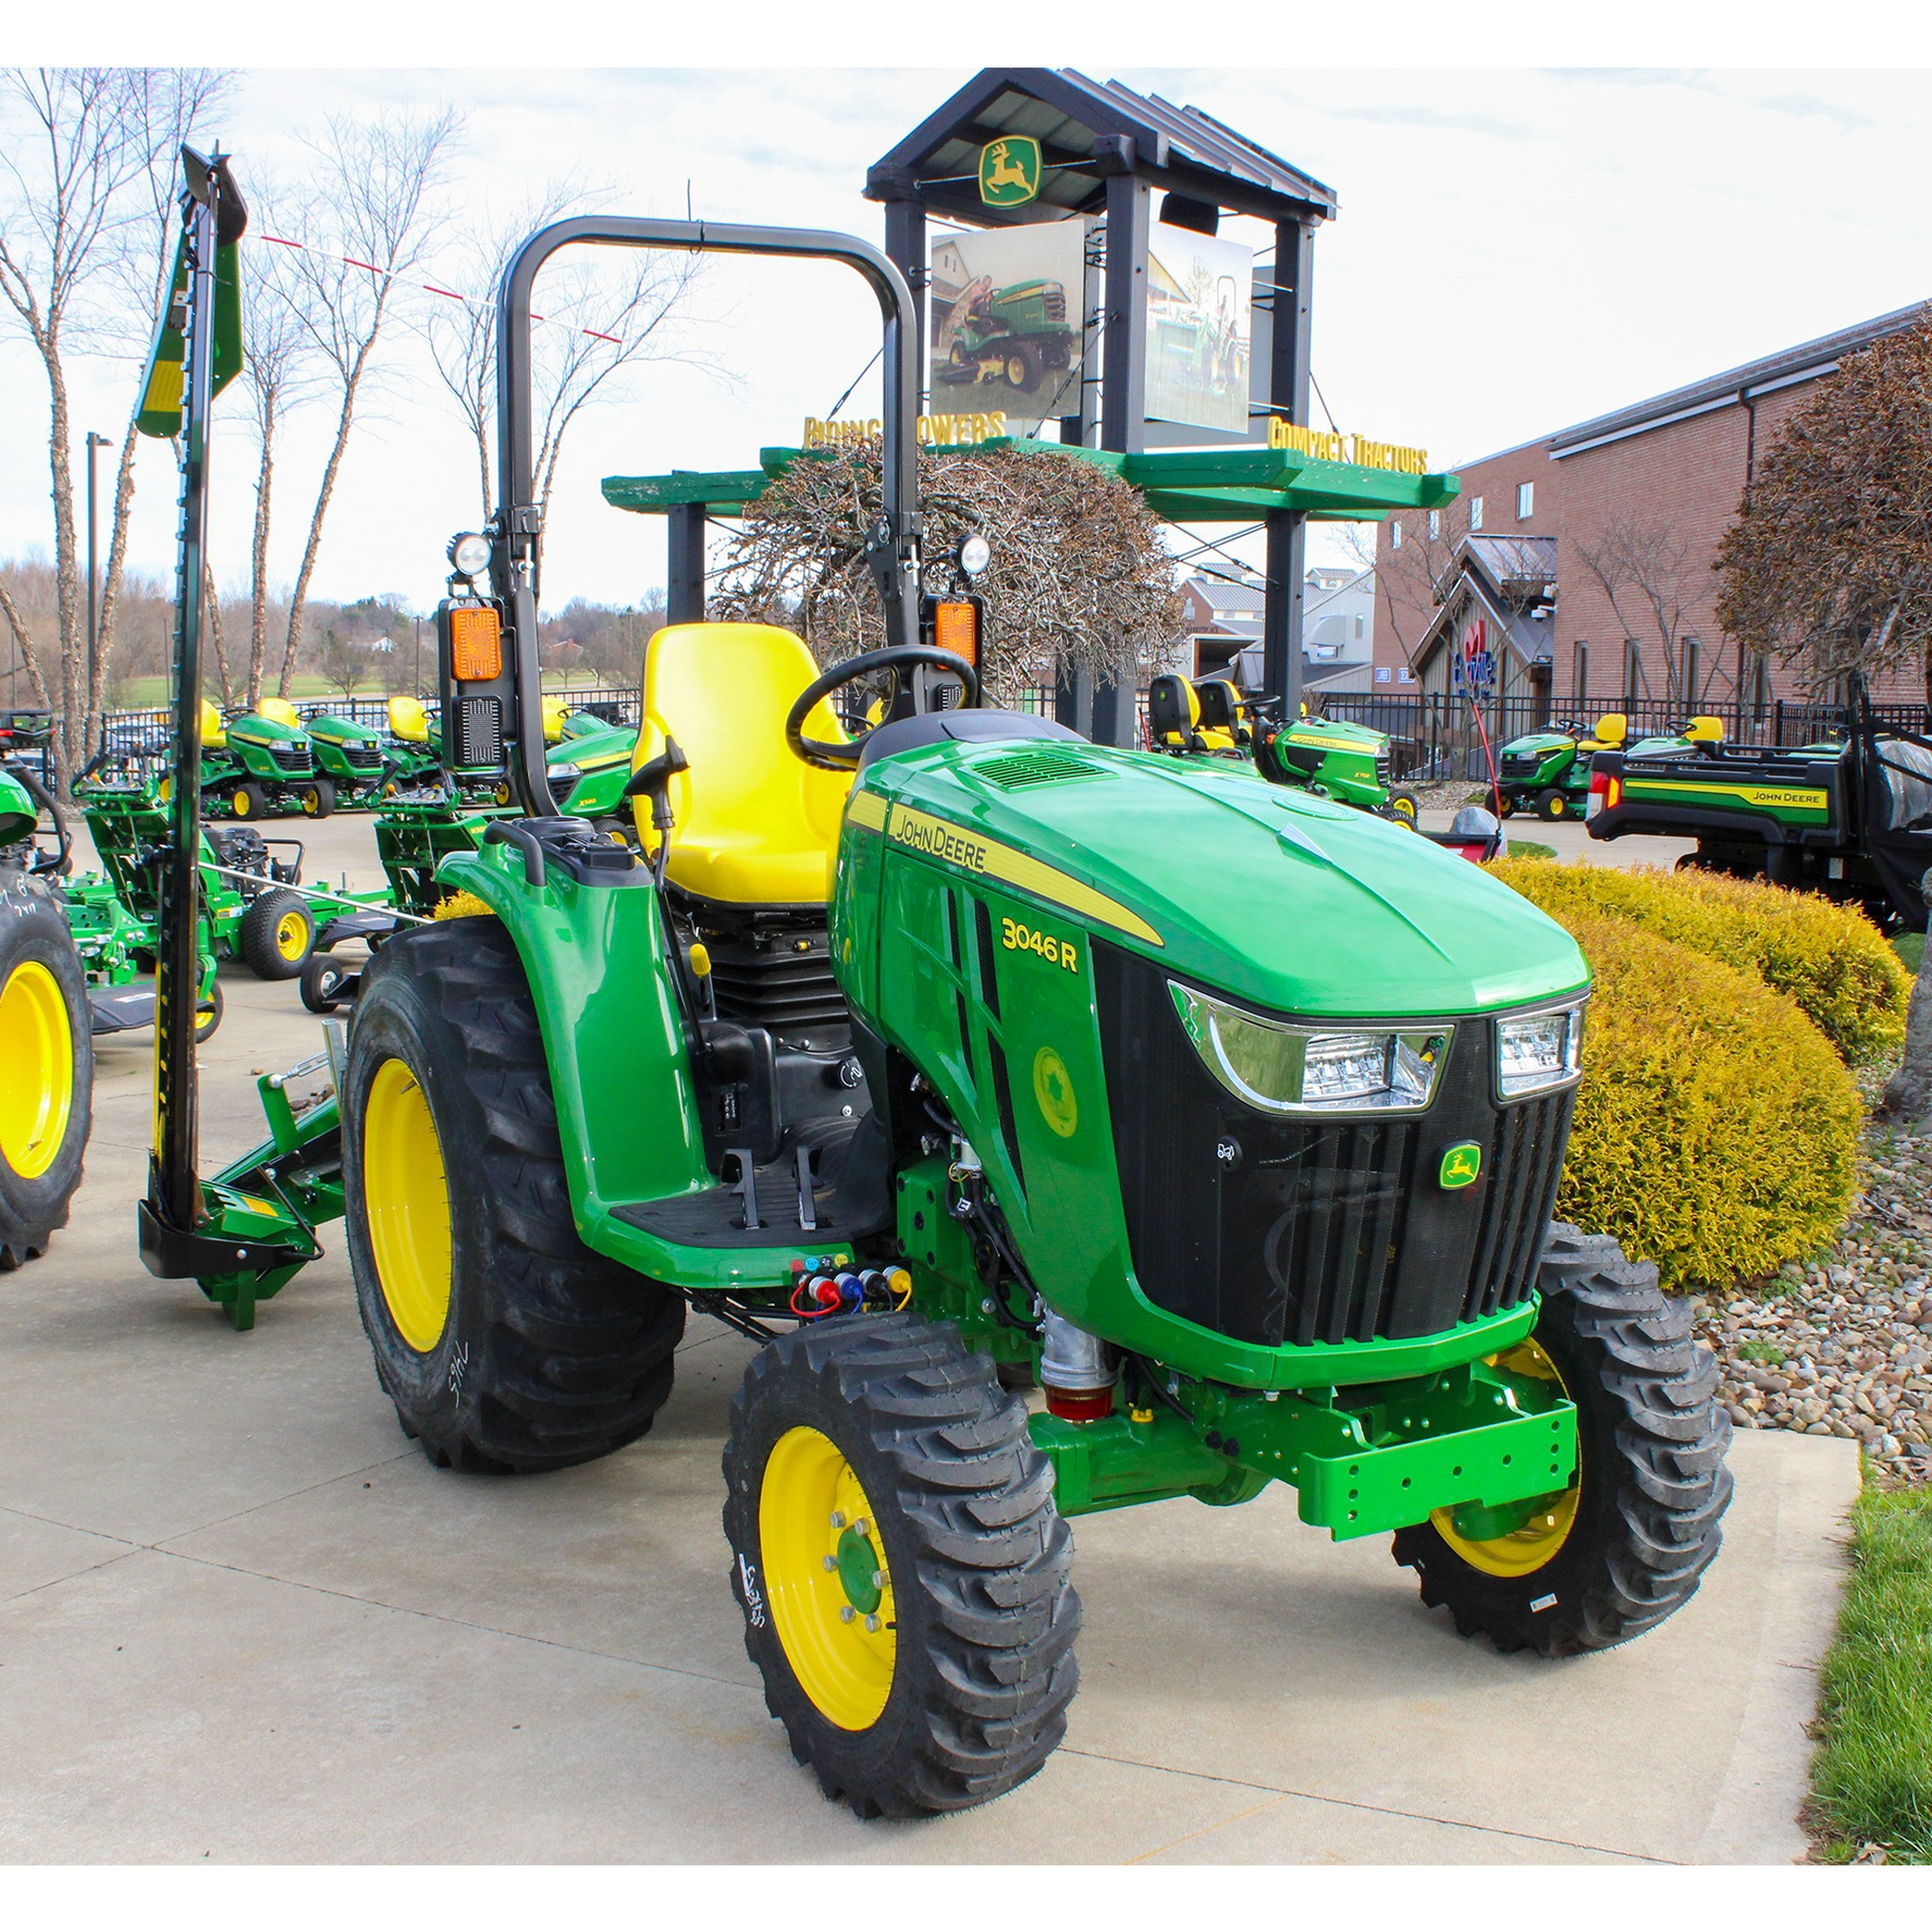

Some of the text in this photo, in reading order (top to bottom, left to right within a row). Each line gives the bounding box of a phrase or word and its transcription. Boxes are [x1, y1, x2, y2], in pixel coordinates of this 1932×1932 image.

[916, 411, 1007, 446] OWERS
[1753, 791, 1820, 803] JOHN DEERE
[897, 814, 987, 871] JOHN DEERE
